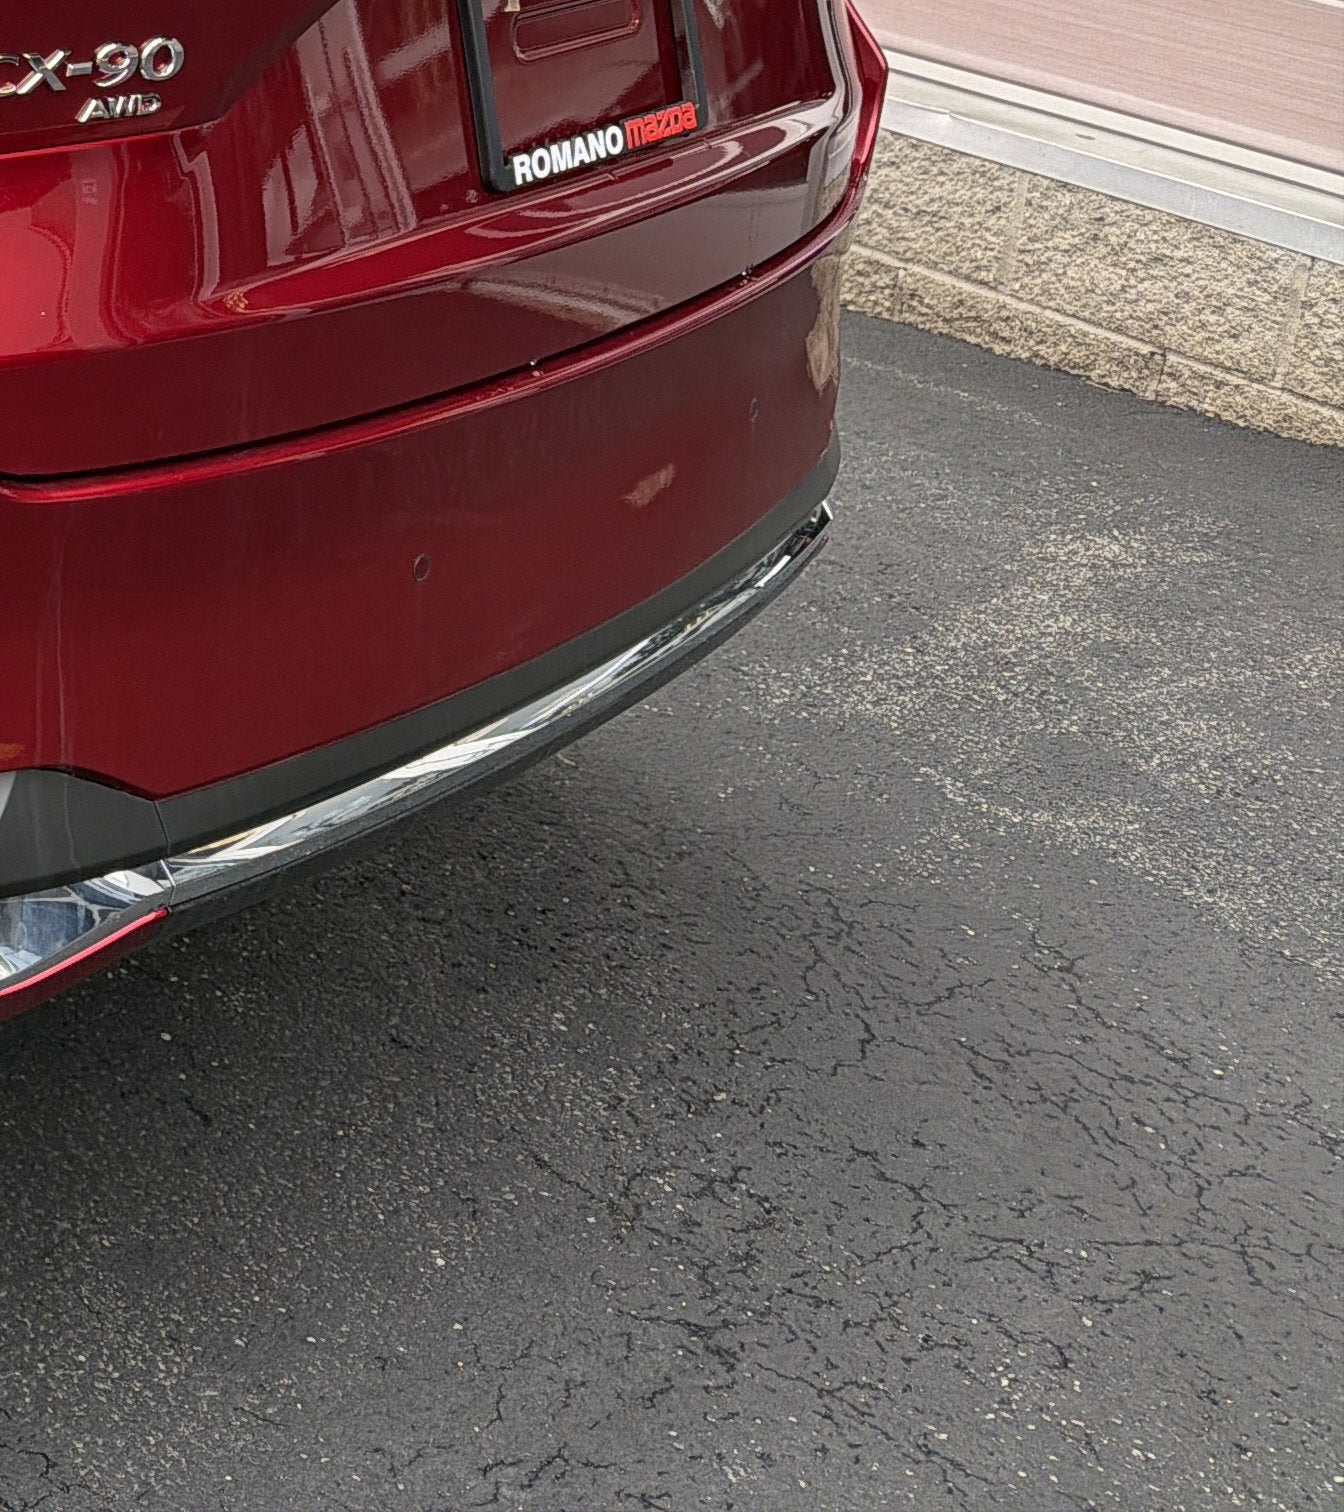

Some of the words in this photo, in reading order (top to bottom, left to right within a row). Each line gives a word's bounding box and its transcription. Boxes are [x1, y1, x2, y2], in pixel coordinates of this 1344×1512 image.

[75, 93, 162, 123] AWD
[512, 124, 624, 186] ROMANO
[625, 101, 698, 151] mazda
